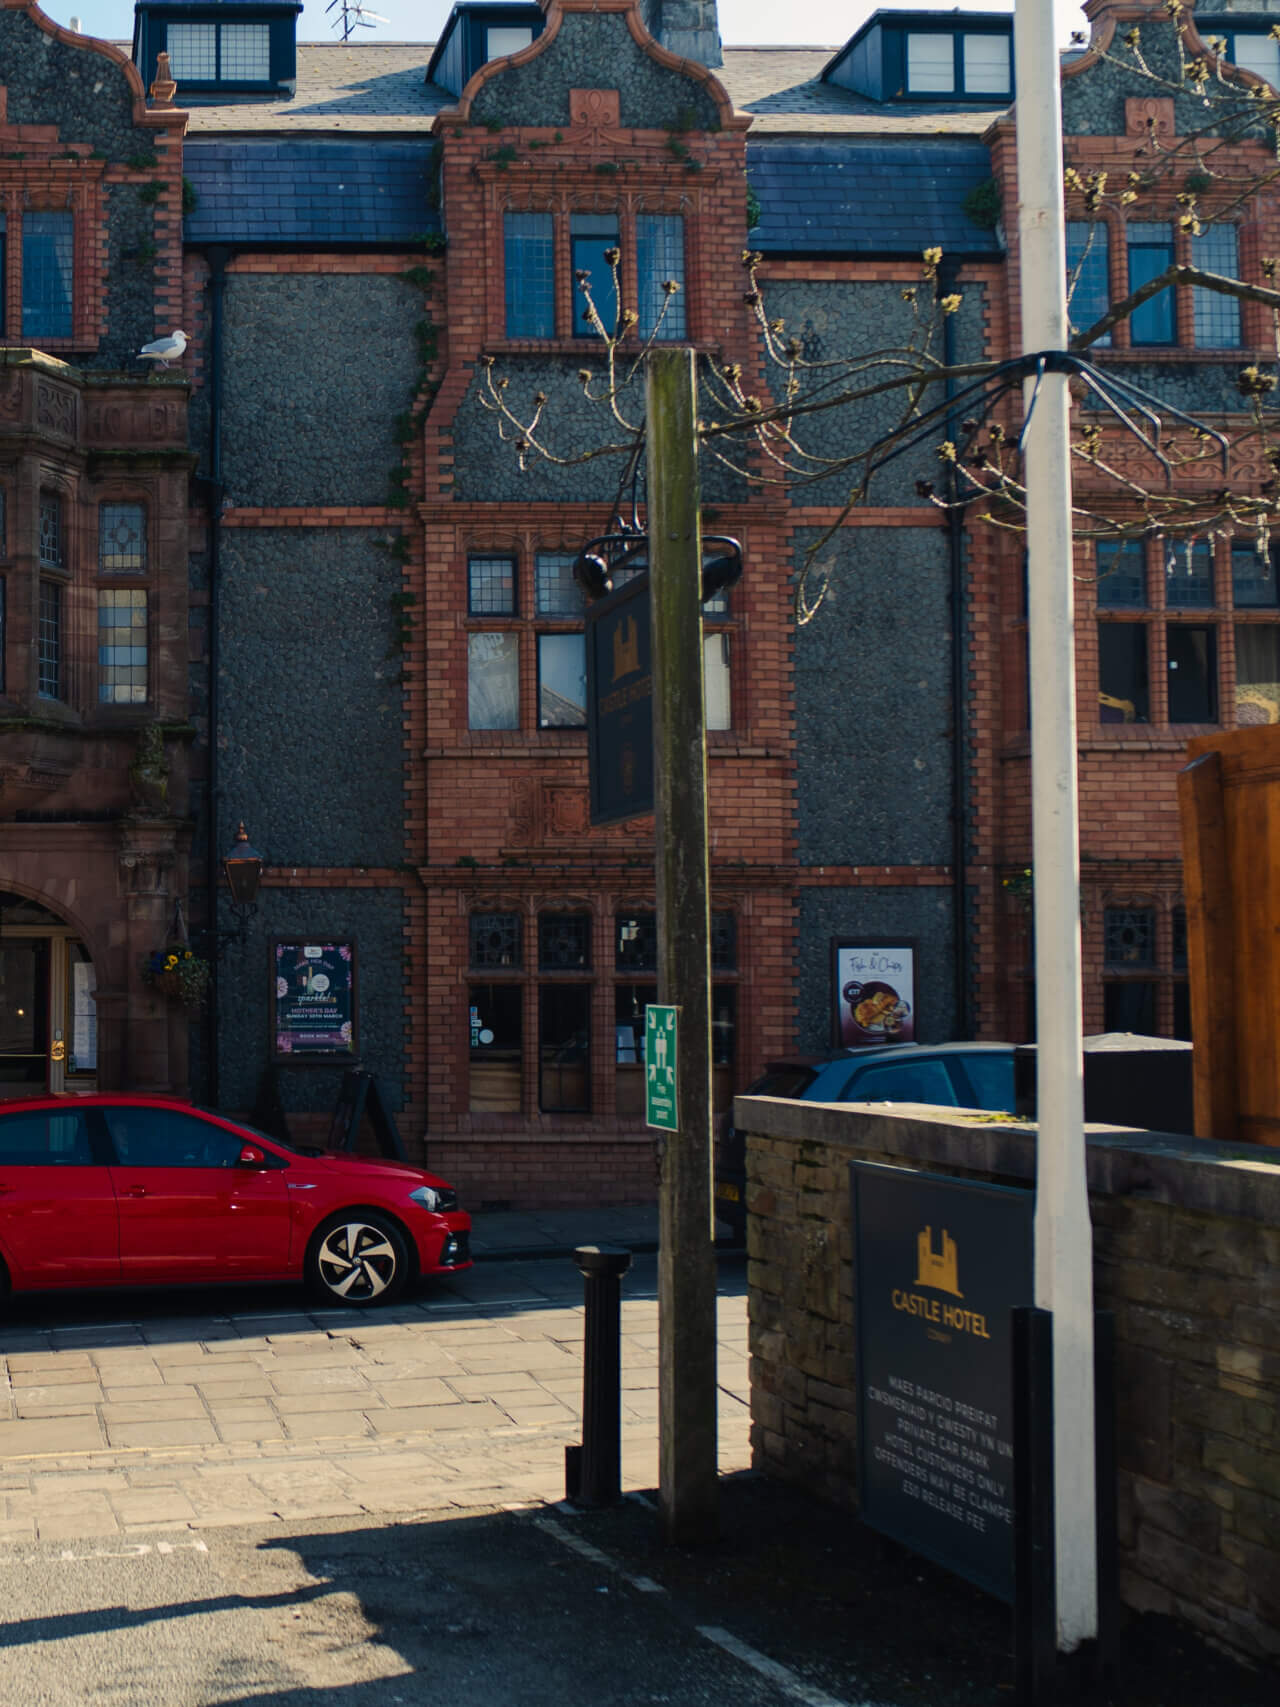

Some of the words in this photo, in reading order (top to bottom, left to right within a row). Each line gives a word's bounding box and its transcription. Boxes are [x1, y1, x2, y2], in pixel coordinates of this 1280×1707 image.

[891, 1288, 941, 1323] CASTLE
[943, 1303, 992, 1339] HOTEL
[888, 1374, 914, 1397] MAES
[916, 1385, 952, 1412] PARCIO
[954, 1400, 998, 1431] PREIFAT
[928, 1411, 936, 1425] Y
[883, 1431, 914, 1457] HOTEL
[915, 1445, 975, 1485] CUSTOMERS
[976, 1473, 1006, 1499] ONLY
[896, 1417, 937, 1447] PRIVATE
[938, 1435, 960, 1457] CAR
[961, 1445, 990, 1472] PARK
[873, 1445, 928, 1483] OFFENDERS
[928, 1472, 951, 1495] MAY
[952, 1483, 967, 1503] BE
[968, 1490, 1013, 1525] CLAMPE
[921, 1488, 965, 1522] RELEASE
[965, 1510, 987, 1534] FEE
